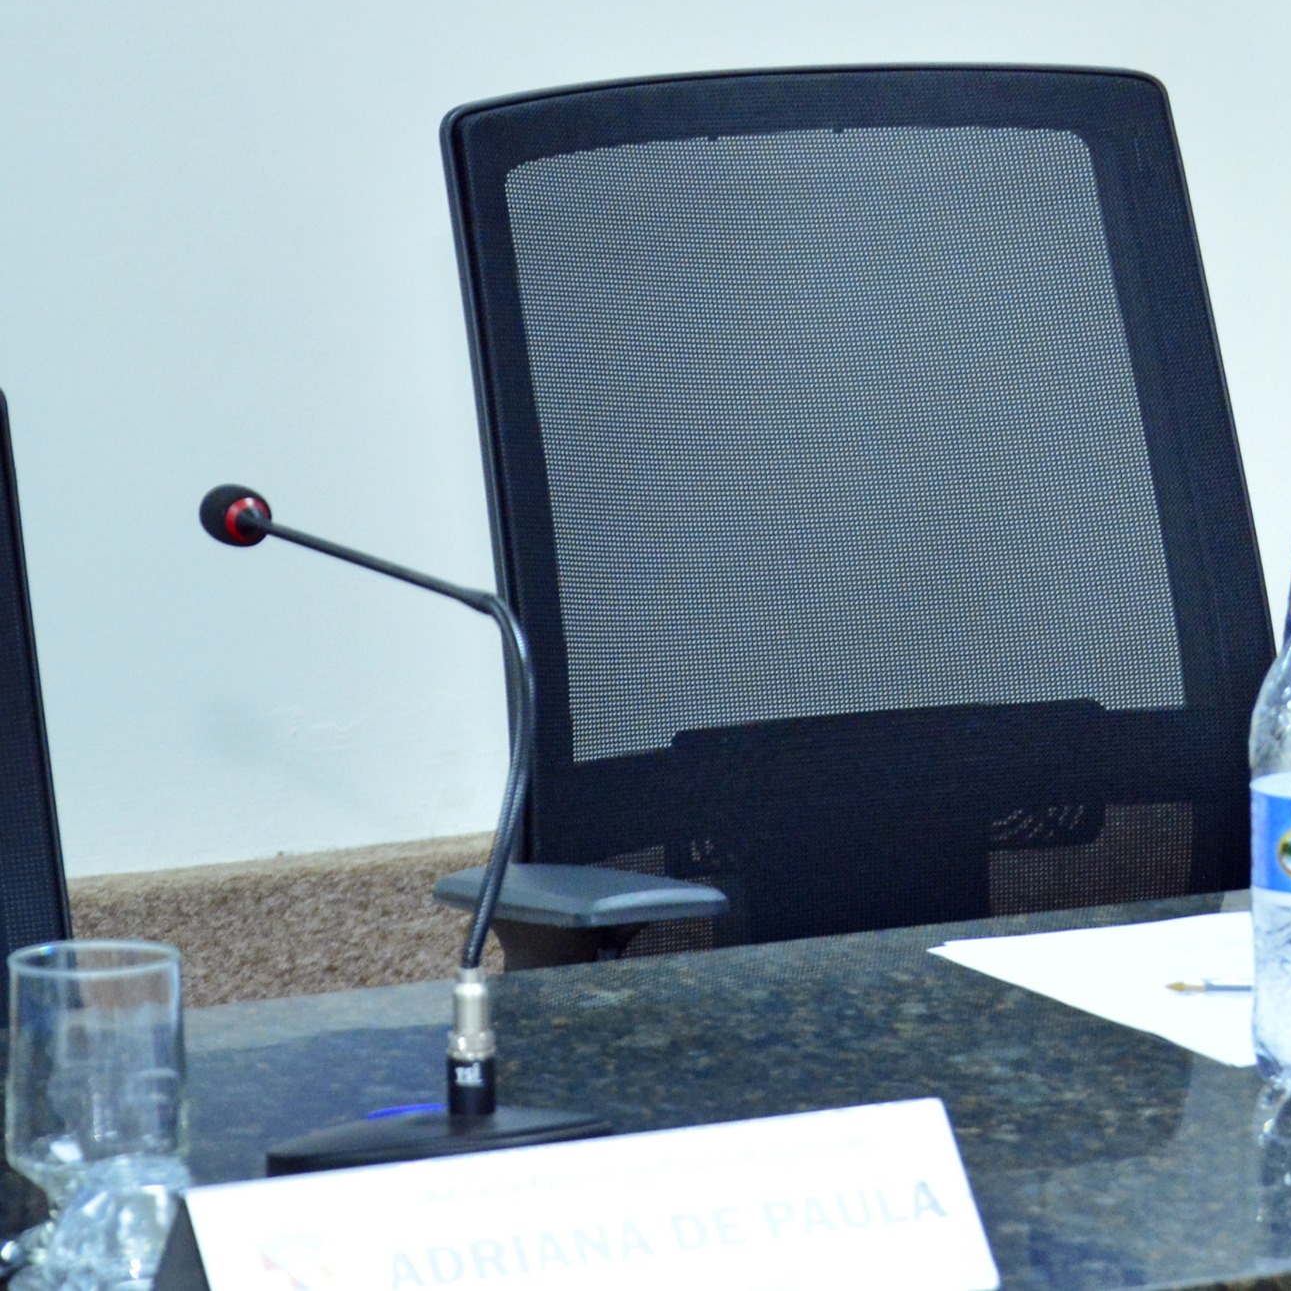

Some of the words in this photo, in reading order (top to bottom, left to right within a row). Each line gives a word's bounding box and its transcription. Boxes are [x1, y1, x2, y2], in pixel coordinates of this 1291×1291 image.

[390, 1215, 656, 1291] ADRIANA
[669, 1206, 750, 1254] DE
[761, 1178, 949, 1241] PAULA
